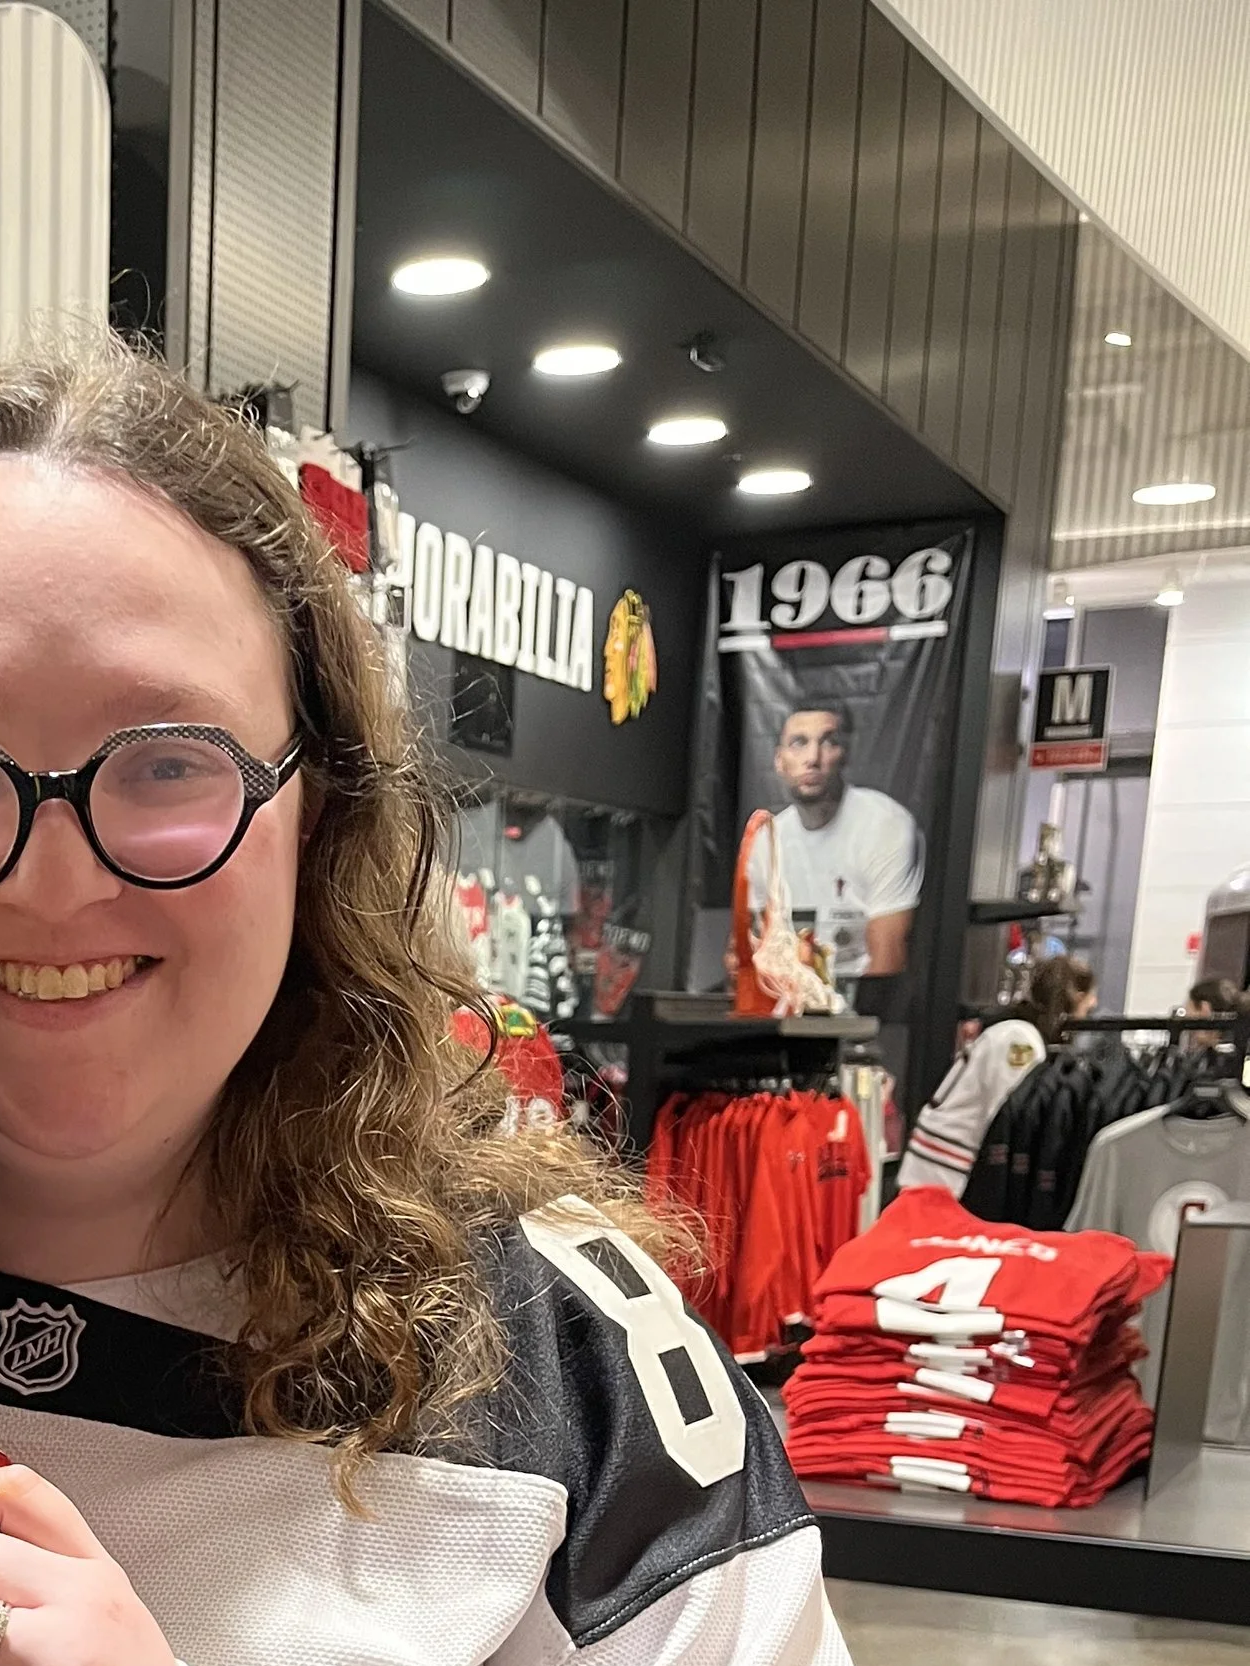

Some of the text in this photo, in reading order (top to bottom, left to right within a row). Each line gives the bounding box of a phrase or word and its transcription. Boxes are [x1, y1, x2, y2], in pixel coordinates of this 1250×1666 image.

[719, 547, 954, 631] 1966
[1051, 673, 1094, 724] M
[871, 1256, 1003, 1312] 4
[10, 1327, 63, 1370] LNH
[518, 1194, 747, 1488] 8
